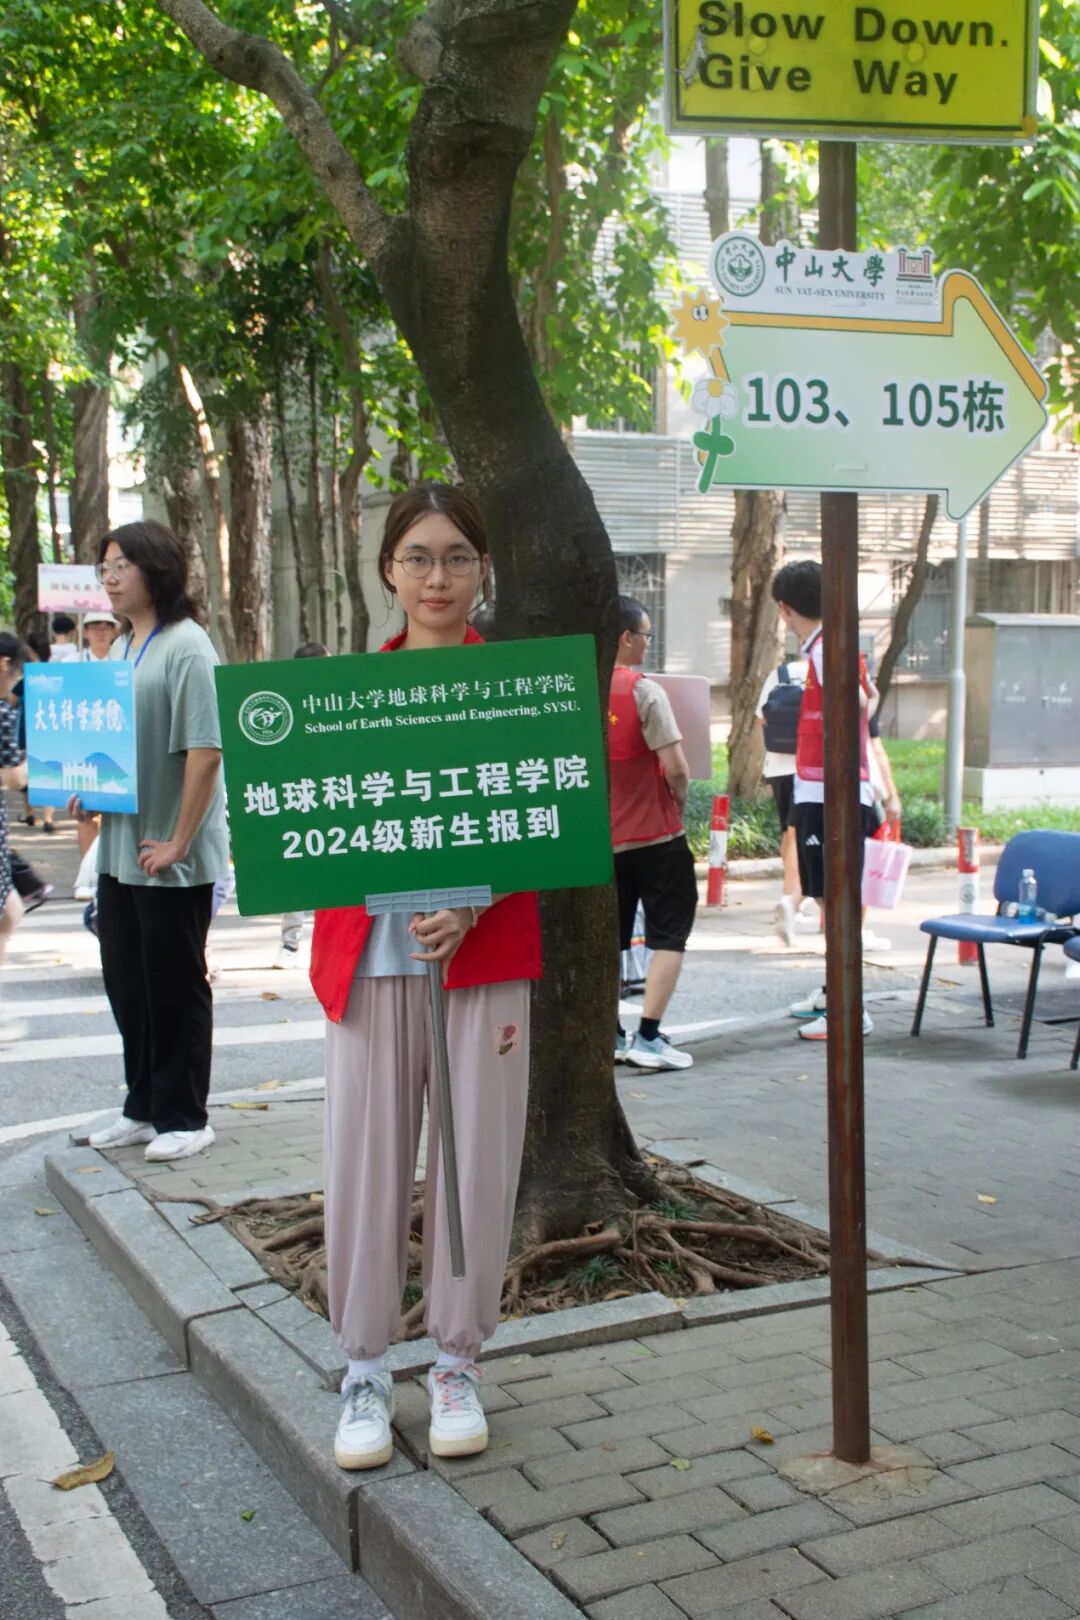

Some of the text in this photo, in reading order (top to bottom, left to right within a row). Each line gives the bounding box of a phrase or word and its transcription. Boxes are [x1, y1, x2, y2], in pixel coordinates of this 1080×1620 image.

[700, 0, 1009, 47] Slow Down.
[700, 53, 958, 104] Give Way
[775, 246, 886, 287] 中山大學
[775, 286, 792, 295] SUN
[797, 287, 833, 297] YAT-SEN
[835, 289, 886, 301] UNIVERSITY
[302, 673, 576, 715] 中山大学地球科学与工程学院
[305, 700, 581, 734] School of Earth Sciences and Engineering, SYSU.
[243, 755, 590, 817] 地球科学与工程学院
[282, 805, 561, 860] 2024级新生报到
